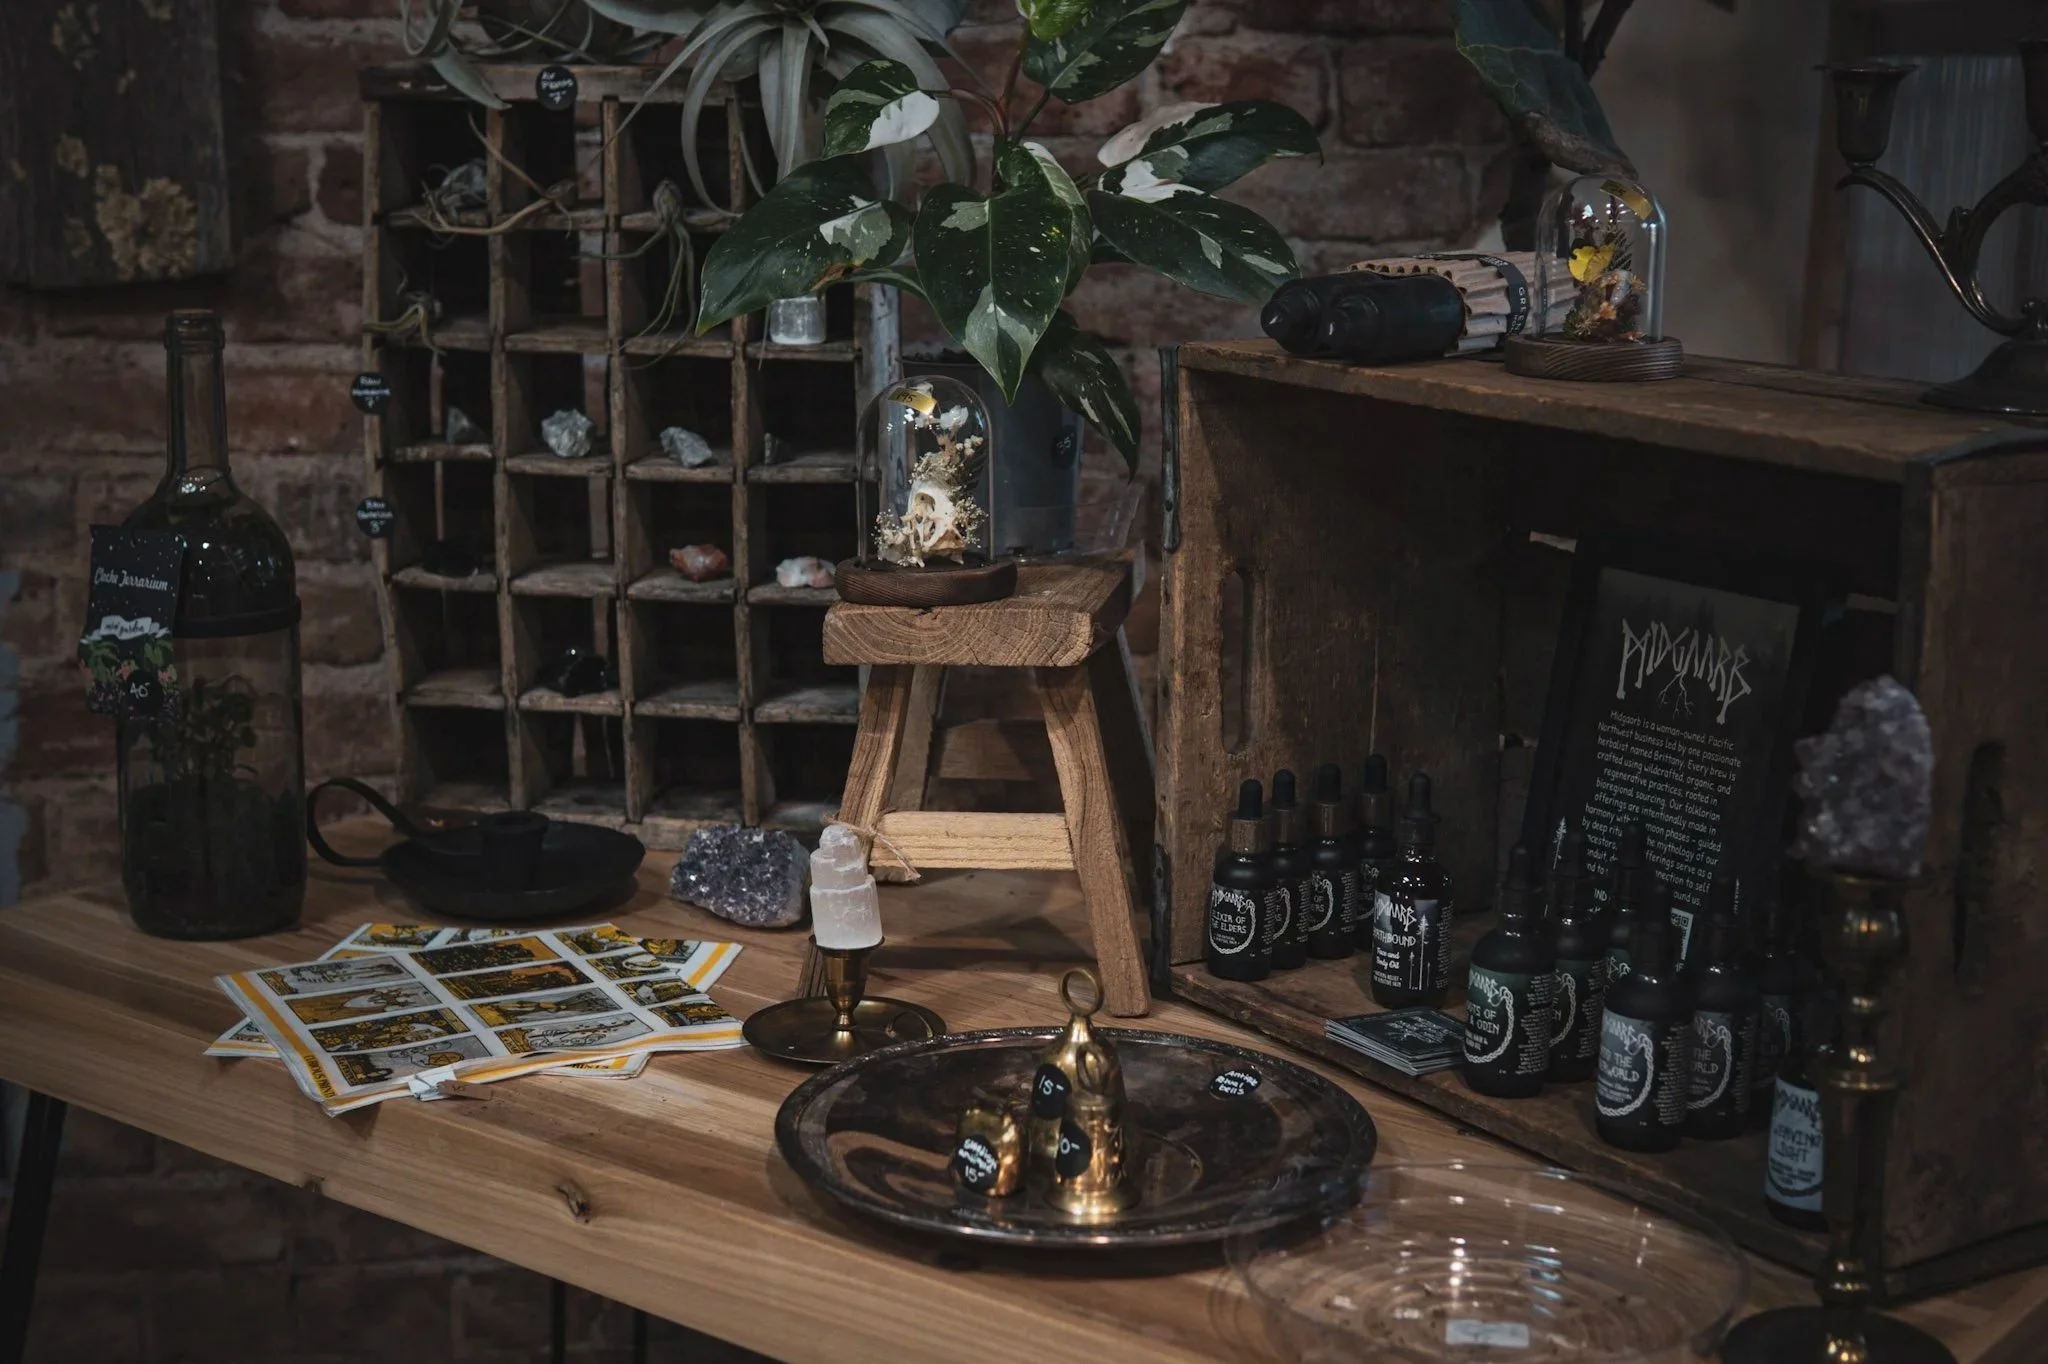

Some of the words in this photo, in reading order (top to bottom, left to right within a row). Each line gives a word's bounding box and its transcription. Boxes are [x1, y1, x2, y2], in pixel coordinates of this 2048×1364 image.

[94, 567, 119, 586] Cloche
[119, 569, 169, 592] Terrarium
[1598, 721, 1633, 738] Northwest
[1634, 731, 1664, 747] business
[1665, 738, 1677, 751] led
[1677, 742, 1687, 757] by
[1688, 747, 1701, 758] one
[1702, 750, 1742, 769] passionate
[1642, 719, 1650, 729] is
[1650, 722, 1656, 731] a
[1707, 735, 1735, 751] Pacific
[1596, 750, 1624, 766] crafted
[1624, 757, 1643, 776] using
[1716, 781, 1732, 796] and
[1597, 734, 1629, 752] herbalist
[1630, 745, 1653, 760] named
[1687, 759, 1708, 777] Every
[1709, 765, 1728, 780] brew
[1729, 770, 1737, 782] is
[1596, 777, 1634, 798] bioregional
[1669, 798, 1684, 811] Our
[1603, 767, 1647, 787] regenerative
[1685, 789, 1709, 804] rooted
[1709, 796, 1718, 807] in
[1585, 802, 1615, 823] harmony
[1616, 812, 1631, 824] with
[1645, 822, 1665, 836] moon
[1665, 829, 1690, 844] phases
[1697, 838, 1722, 853] guided
[1594, 791, 1627, 812] offerings
[1627, 803, 1640, 814] are
[1641, 807, 1687, 831] intentionally
[1688, 820, 1707, 833] made
[1709, 825, 1718, 837] in
[1582, 816, 1591, 831] by
[1592, 819, 1608, 836] deep
[1646, 836, 1656, 848] he
[1656, 839, 1695, 863] mythology
[1695, 851, 1705, 863] of
[1705, 855, 1720, 866] our
[1645, 848, 1674, 870] fferings
[1675, 860, 1696, 874] serve
[1697, 867, 1706, 878] as
[1707, 870, 1713, 880] a
[1686, 875, 1694, 888] to
[1694, 881, 1711, 895] self
[1220, 921, 1247, 935] ELDERS
[1236, 915, 1247, 925] OF
[1476, 1019, 1500, 1036] ODIN
[1484, 1008, 1497, 1021] OF
[1614, 1051, 1633, 1069] THE
